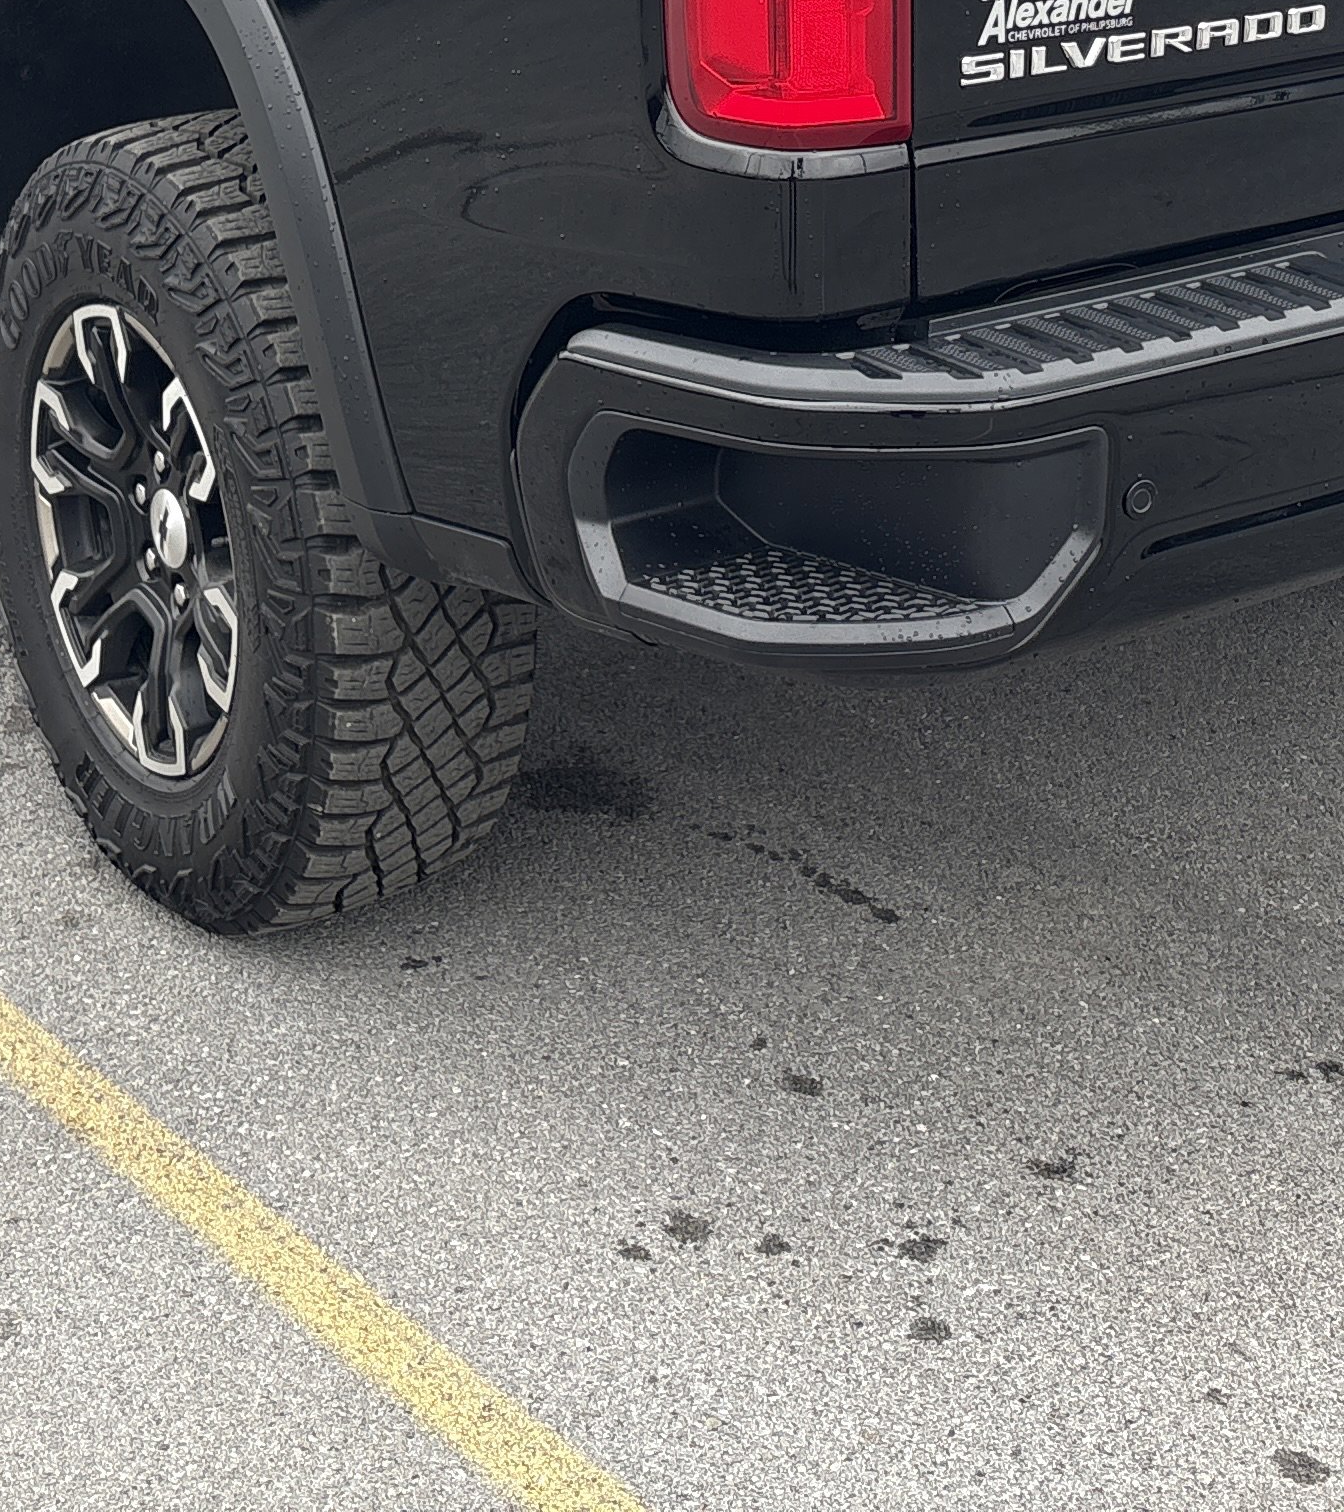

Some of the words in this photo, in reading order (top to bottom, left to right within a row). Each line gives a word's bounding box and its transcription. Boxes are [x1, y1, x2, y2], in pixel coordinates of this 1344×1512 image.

[960, 4, 1327, 87] SILVERADO
[1008, 25, 1066, 43] CHEVROLET
[1068, 23, 1081, 34] OF
[74, 750, 238, 857] WRANGLER
